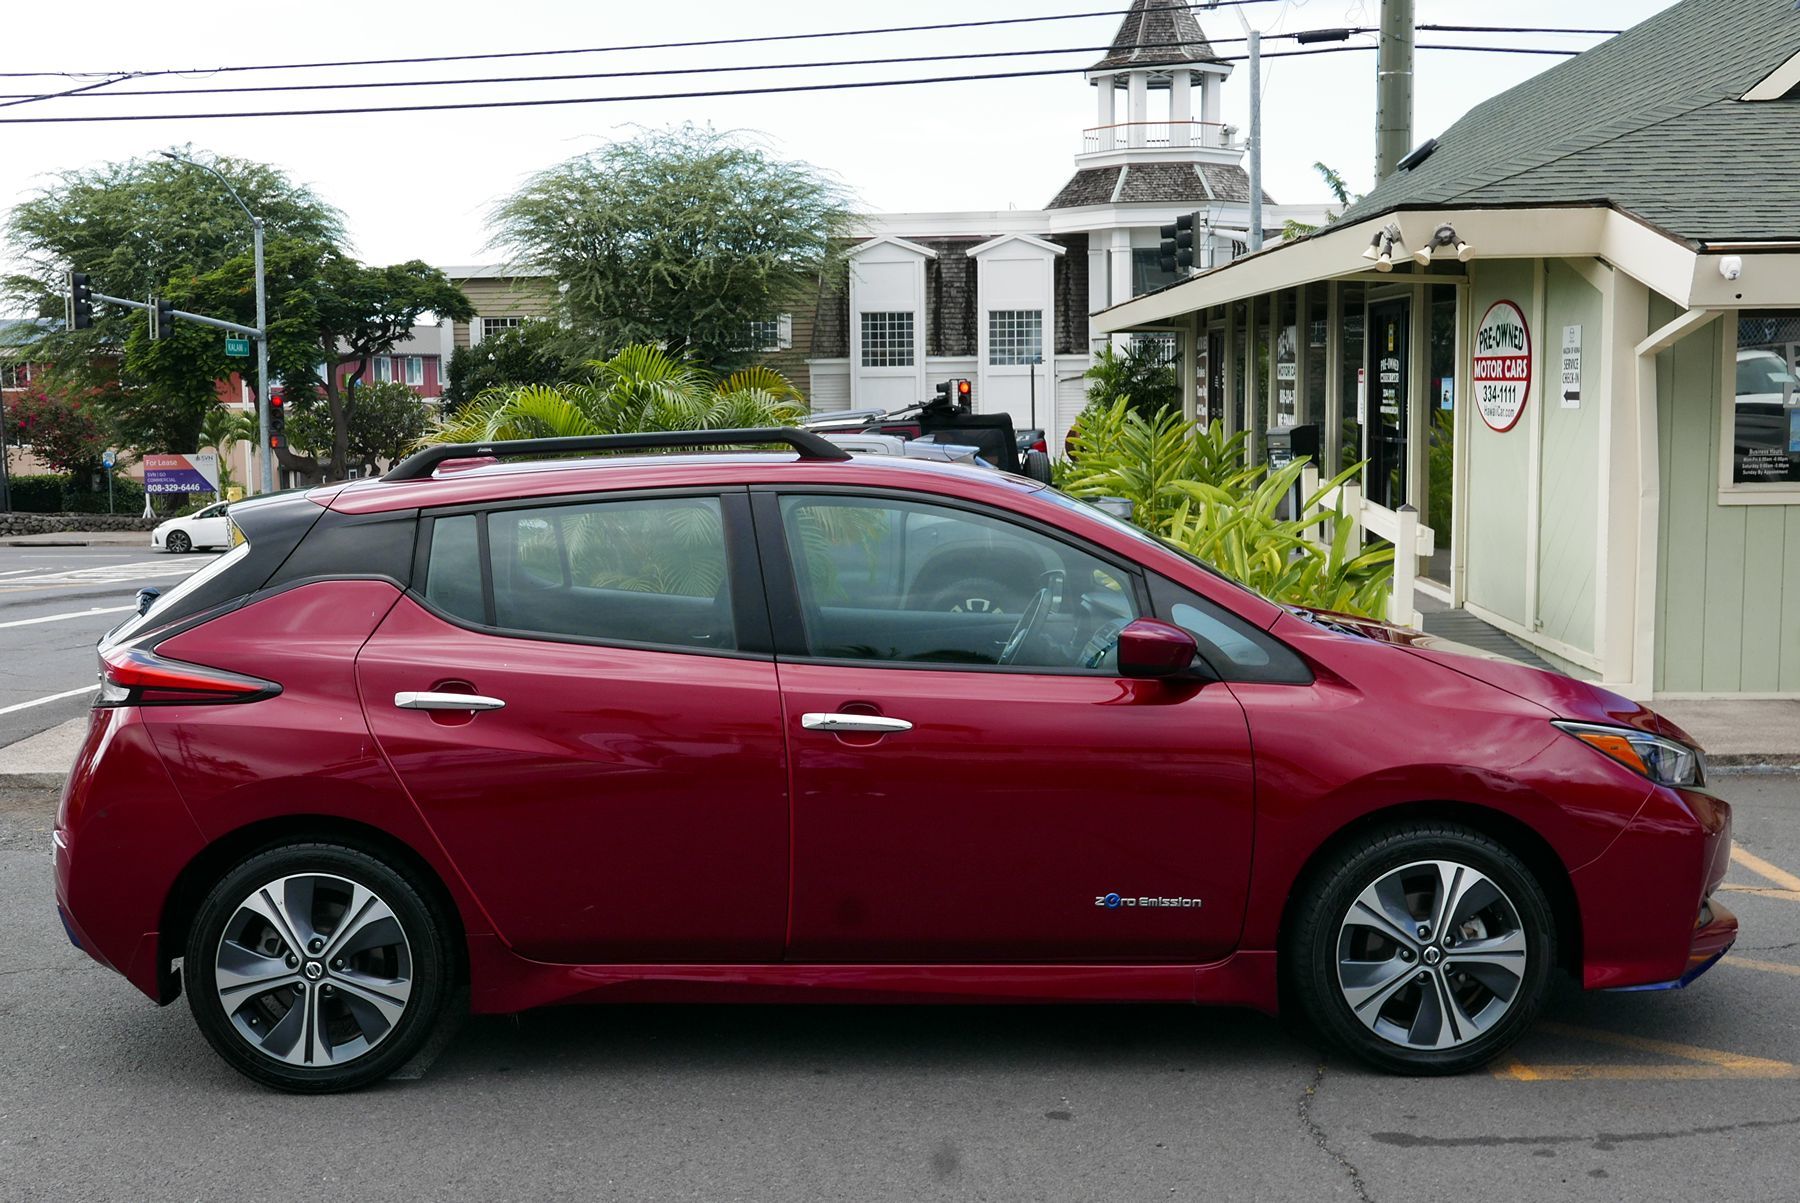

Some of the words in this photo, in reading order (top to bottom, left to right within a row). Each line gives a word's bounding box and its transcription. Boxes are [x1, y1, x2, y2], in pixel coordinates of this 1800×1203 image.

[1479, 323, 1524, 353] PRE-OWNED
[1474, 360, 1503, 378] MOTOR
[1504, 359, 1528, 378] CARS
[1563, 358, 1579, 370] SERVICE
[1562, 372, 1580, 384] CHECK-IN
[1483, 385, 1516, 403] 334-1111
[147, 483, 201, 492] 808-329-6446
[1138, 896, 1202, 908] Emission
